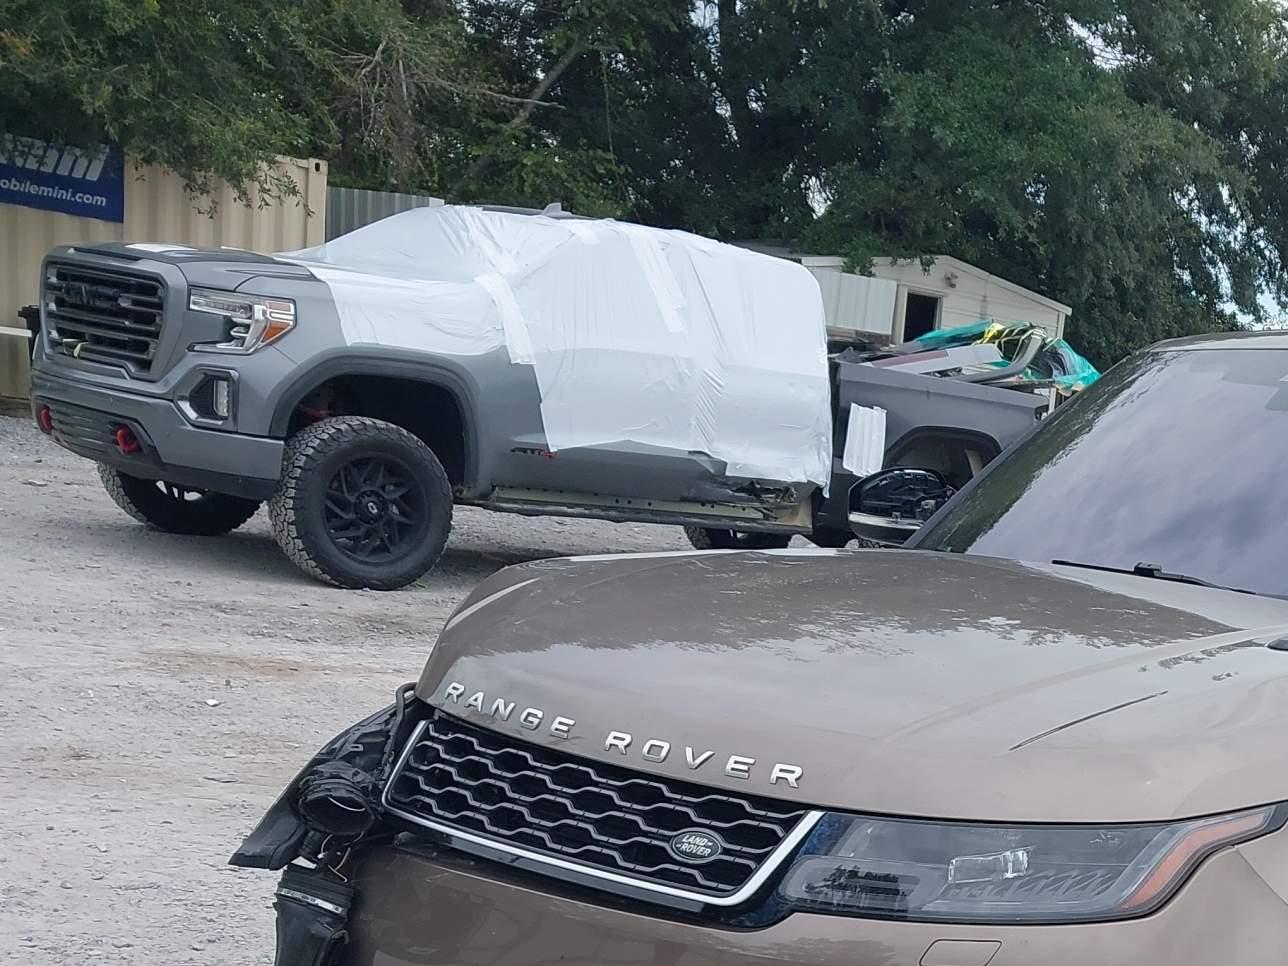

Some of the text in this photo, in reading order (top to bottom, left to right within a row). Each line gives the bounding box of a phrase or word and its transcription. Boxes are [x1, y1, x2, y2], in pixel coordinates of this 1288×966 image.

[444, 681, 804, 789] RANGE ROVER
[682, 834, 709, 846] LAND
[680, 842, 712, 857] ROVER
